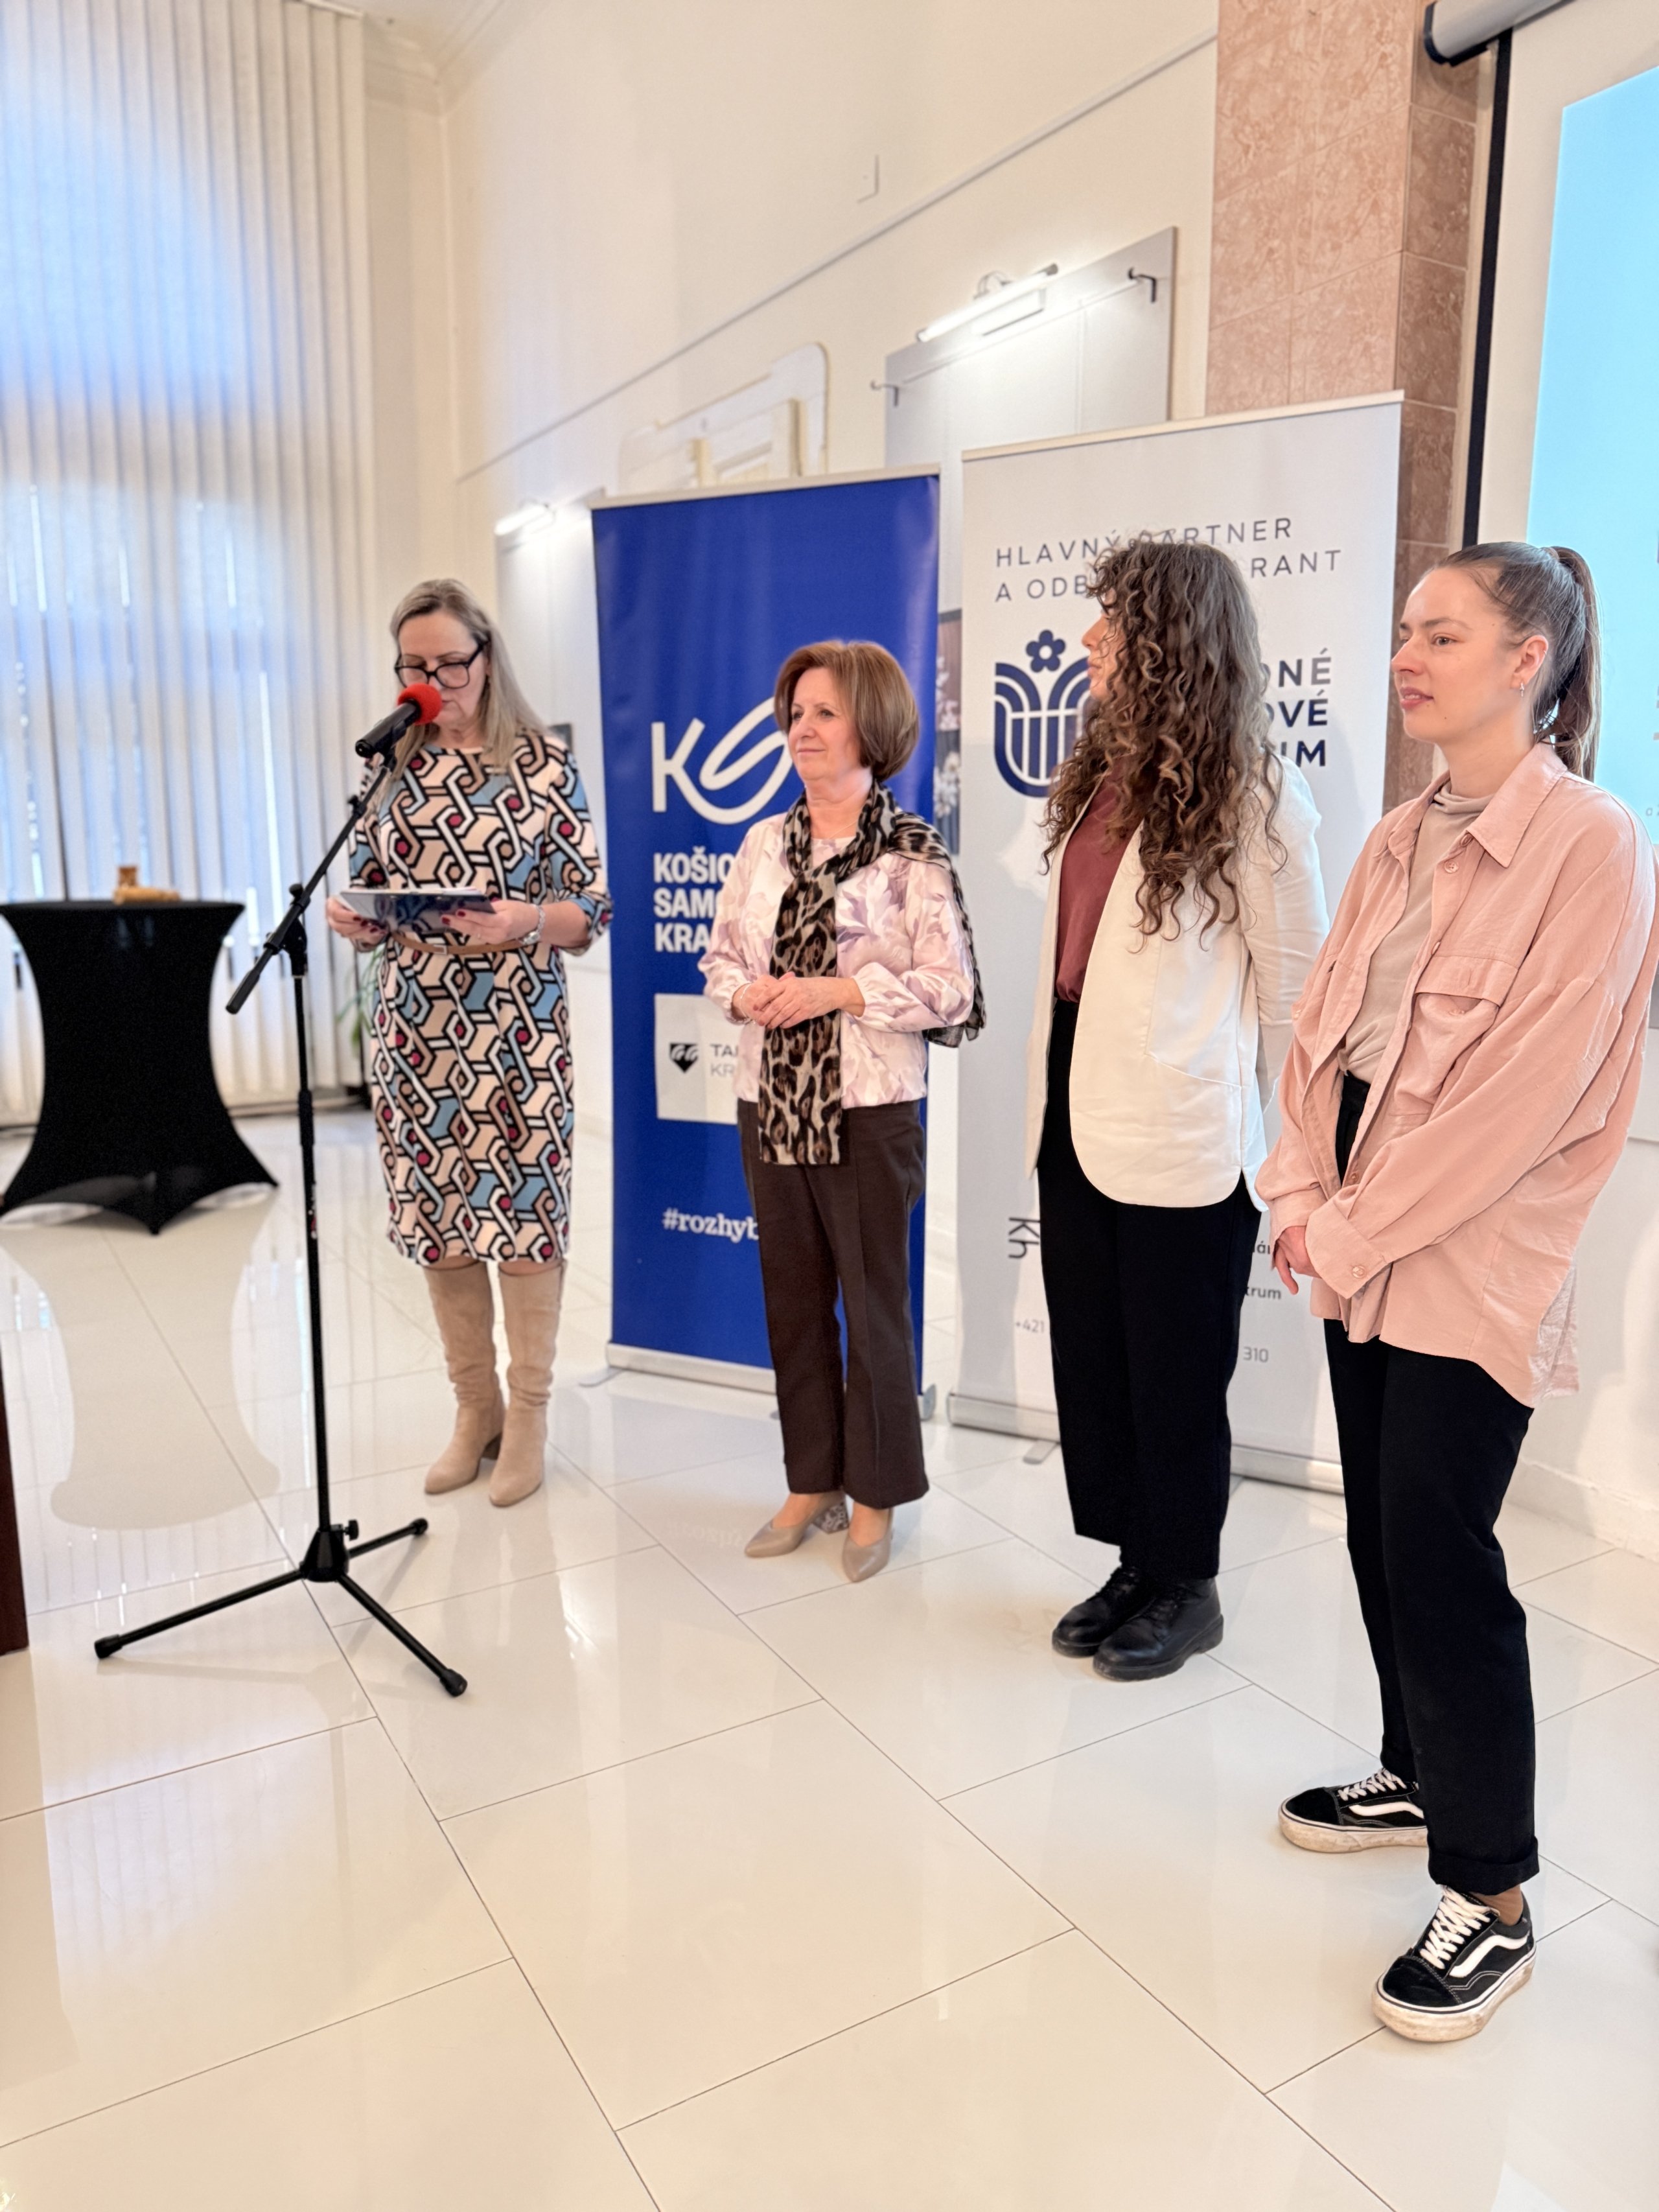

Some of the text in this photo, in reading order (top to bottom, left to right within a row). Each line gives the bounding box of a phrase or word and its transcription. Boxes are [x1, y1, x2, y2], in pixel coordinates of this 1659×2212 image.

[995, 550, 1341, 603] A ODB RANT
[653, 845, 735, 884] KOŠIC
[653, 887, 715, 919] SAM
[655, 922, 711, 953] KRA
[1242, 1346, 1269, 1363] 310
